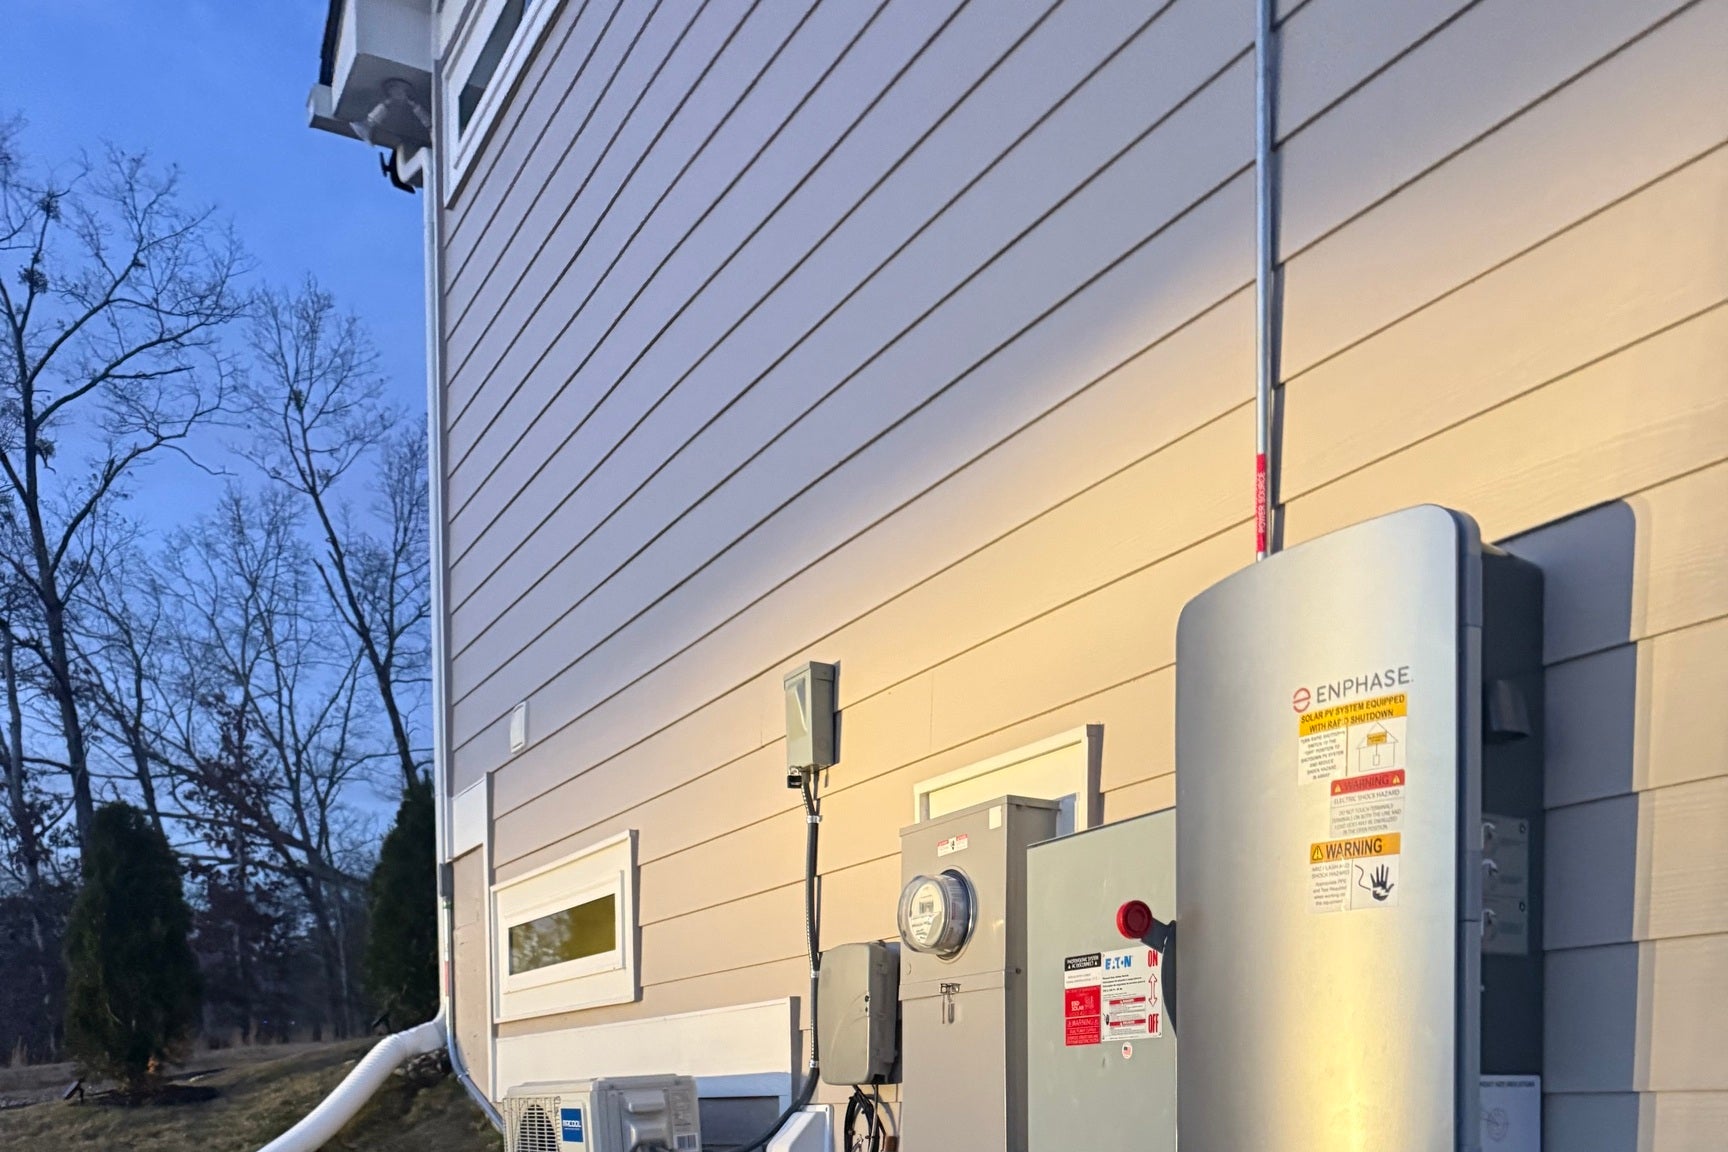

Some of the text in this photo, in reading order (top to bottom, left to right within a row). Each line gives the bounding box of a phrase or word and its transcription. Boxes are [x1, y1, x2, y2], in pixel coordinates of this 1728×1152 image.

[1316, 665, 1410, 704] ENPHASE
[1300, 694, 1405, 724] SOLAR PV SYSTEM EQUIPPED
[1309, 709, 1394, 733] WITH RAPD SHUTDOWN
[1326, 838, 1383, 859] WARNING
[1147, 950, 1159, 968] ON
[1148, 1013, 1160, 1034] OFF
